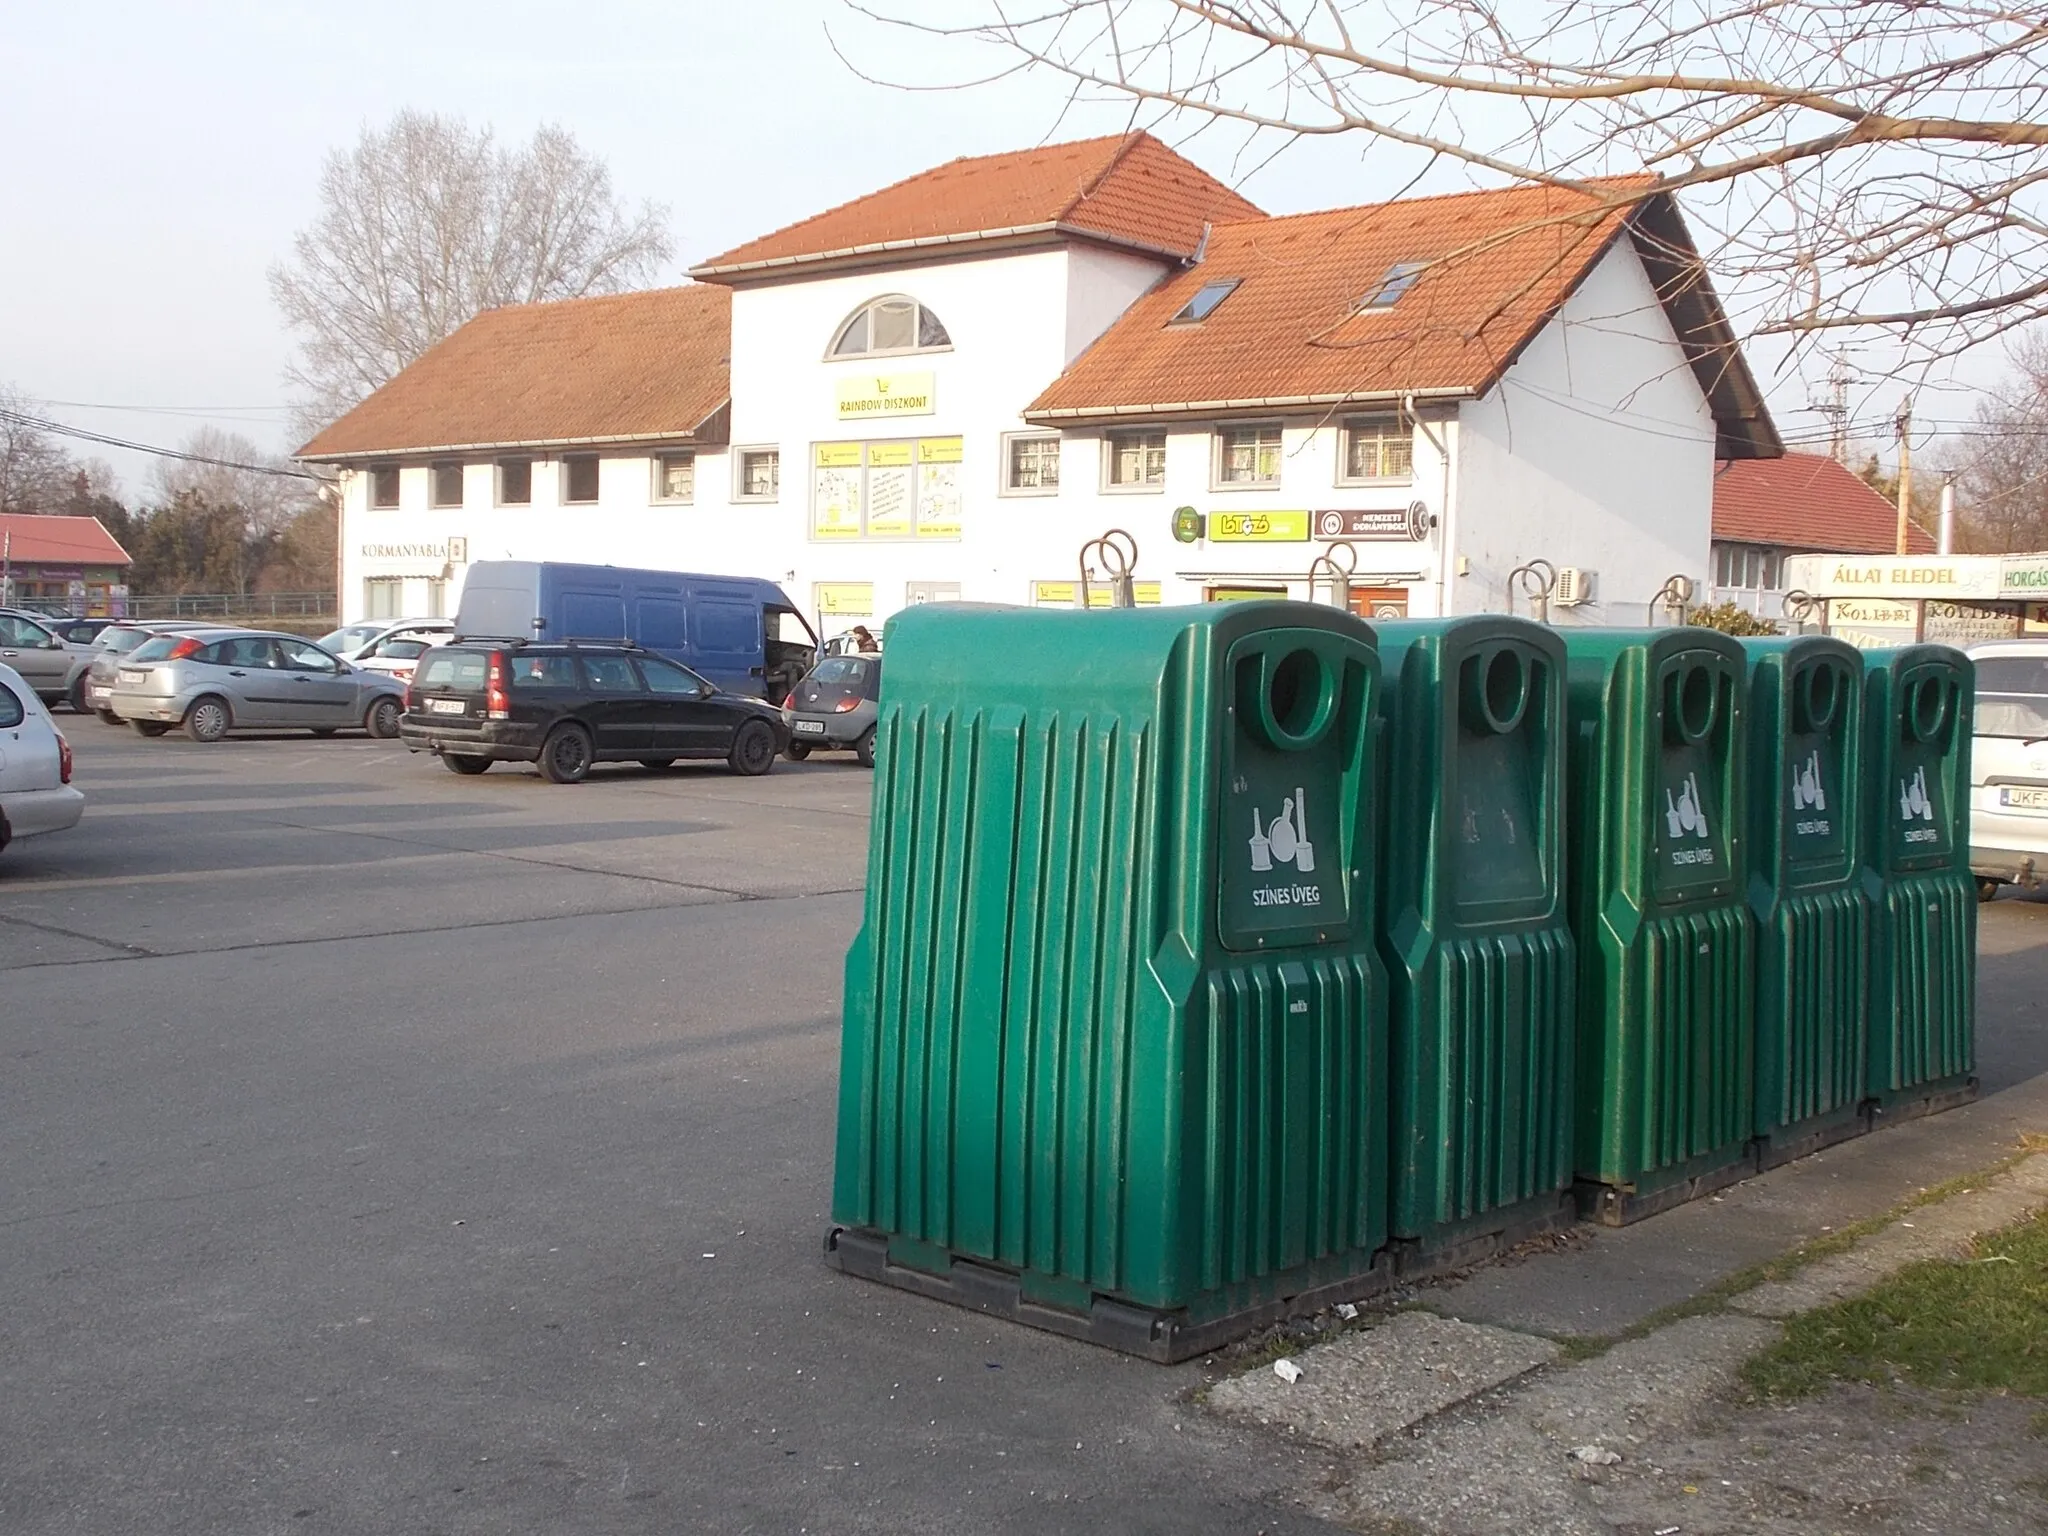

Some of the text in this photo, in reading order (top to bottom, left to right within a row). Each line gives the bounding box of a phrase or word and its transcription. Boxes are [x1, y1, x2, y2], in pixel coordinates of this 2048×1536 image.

[841, 396, 927, 413] RAINBOW DISZKONT
[1362, 513, 1402, 522] NEMZETI
[1833, 564, 1957, 584] ÁLLAT ELEDEL
[1252, 882, 1321, 906] SZÍNES ÜVEG
